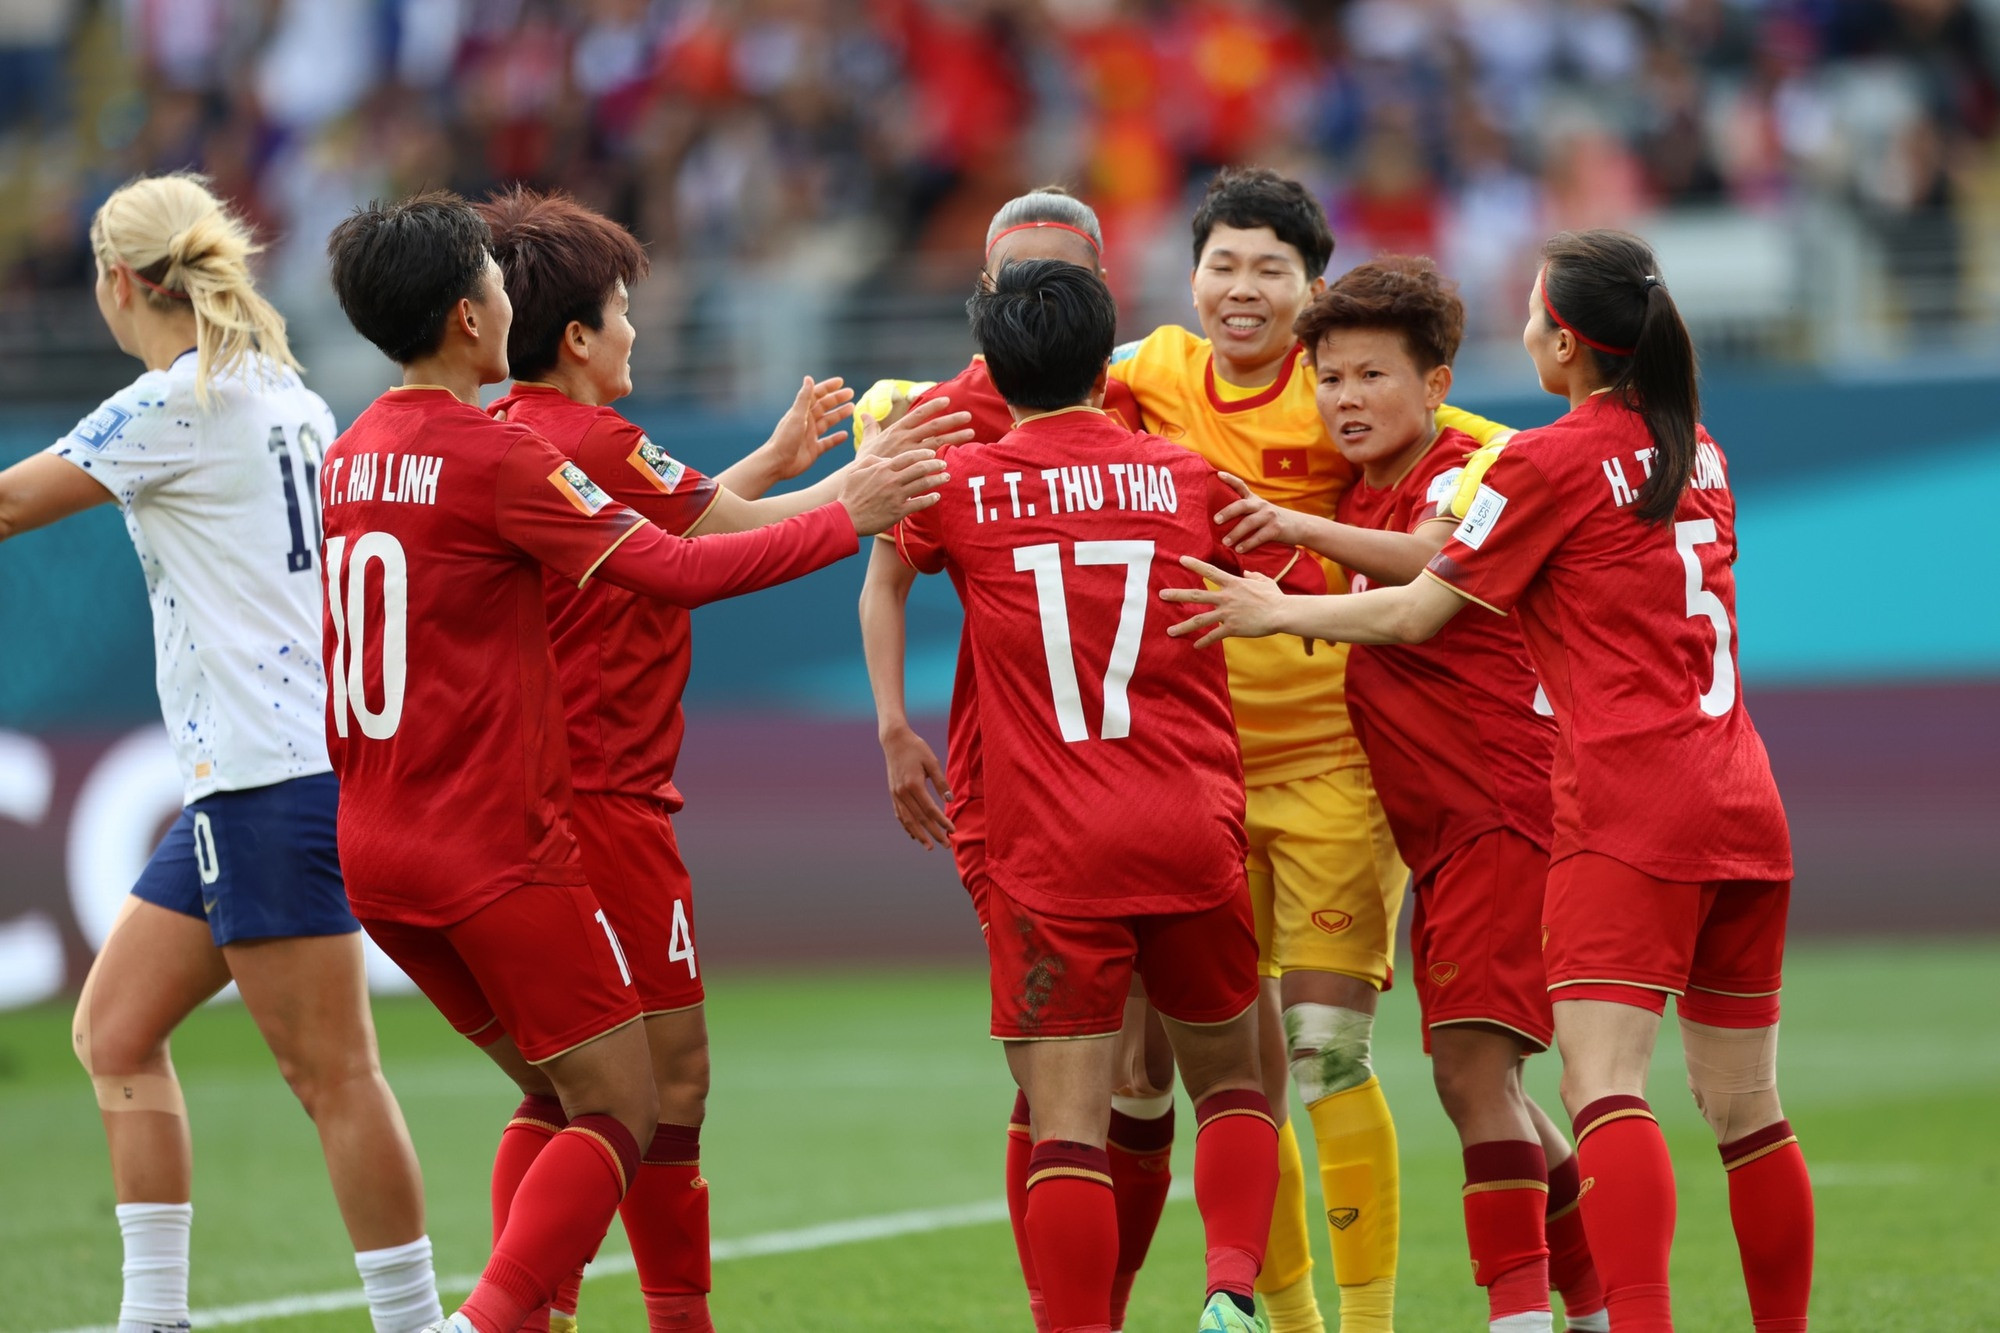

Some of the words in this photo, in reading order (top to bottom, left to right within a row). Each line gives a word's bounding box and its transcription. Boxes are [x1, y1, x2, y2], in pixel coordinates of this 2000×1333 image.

[347, 452, 378, 502] HAI
[382, 453, 443, 505] LINH
[968, 476, 998, 524] T.
[1003, 472, 1035, 518] T.
[1041, 465, 1104, 514] THU
[1108, 464, 1178, 514] THAO
[1602, 457, 1639, 507] H.
[325, 531, 407, 740] 10
[1013, 540, 1155, 742] 17
[1674, 518, 1735, 717] 5
[594, 908, 632, 987] 1
[668, 898, 697, 980] 4
